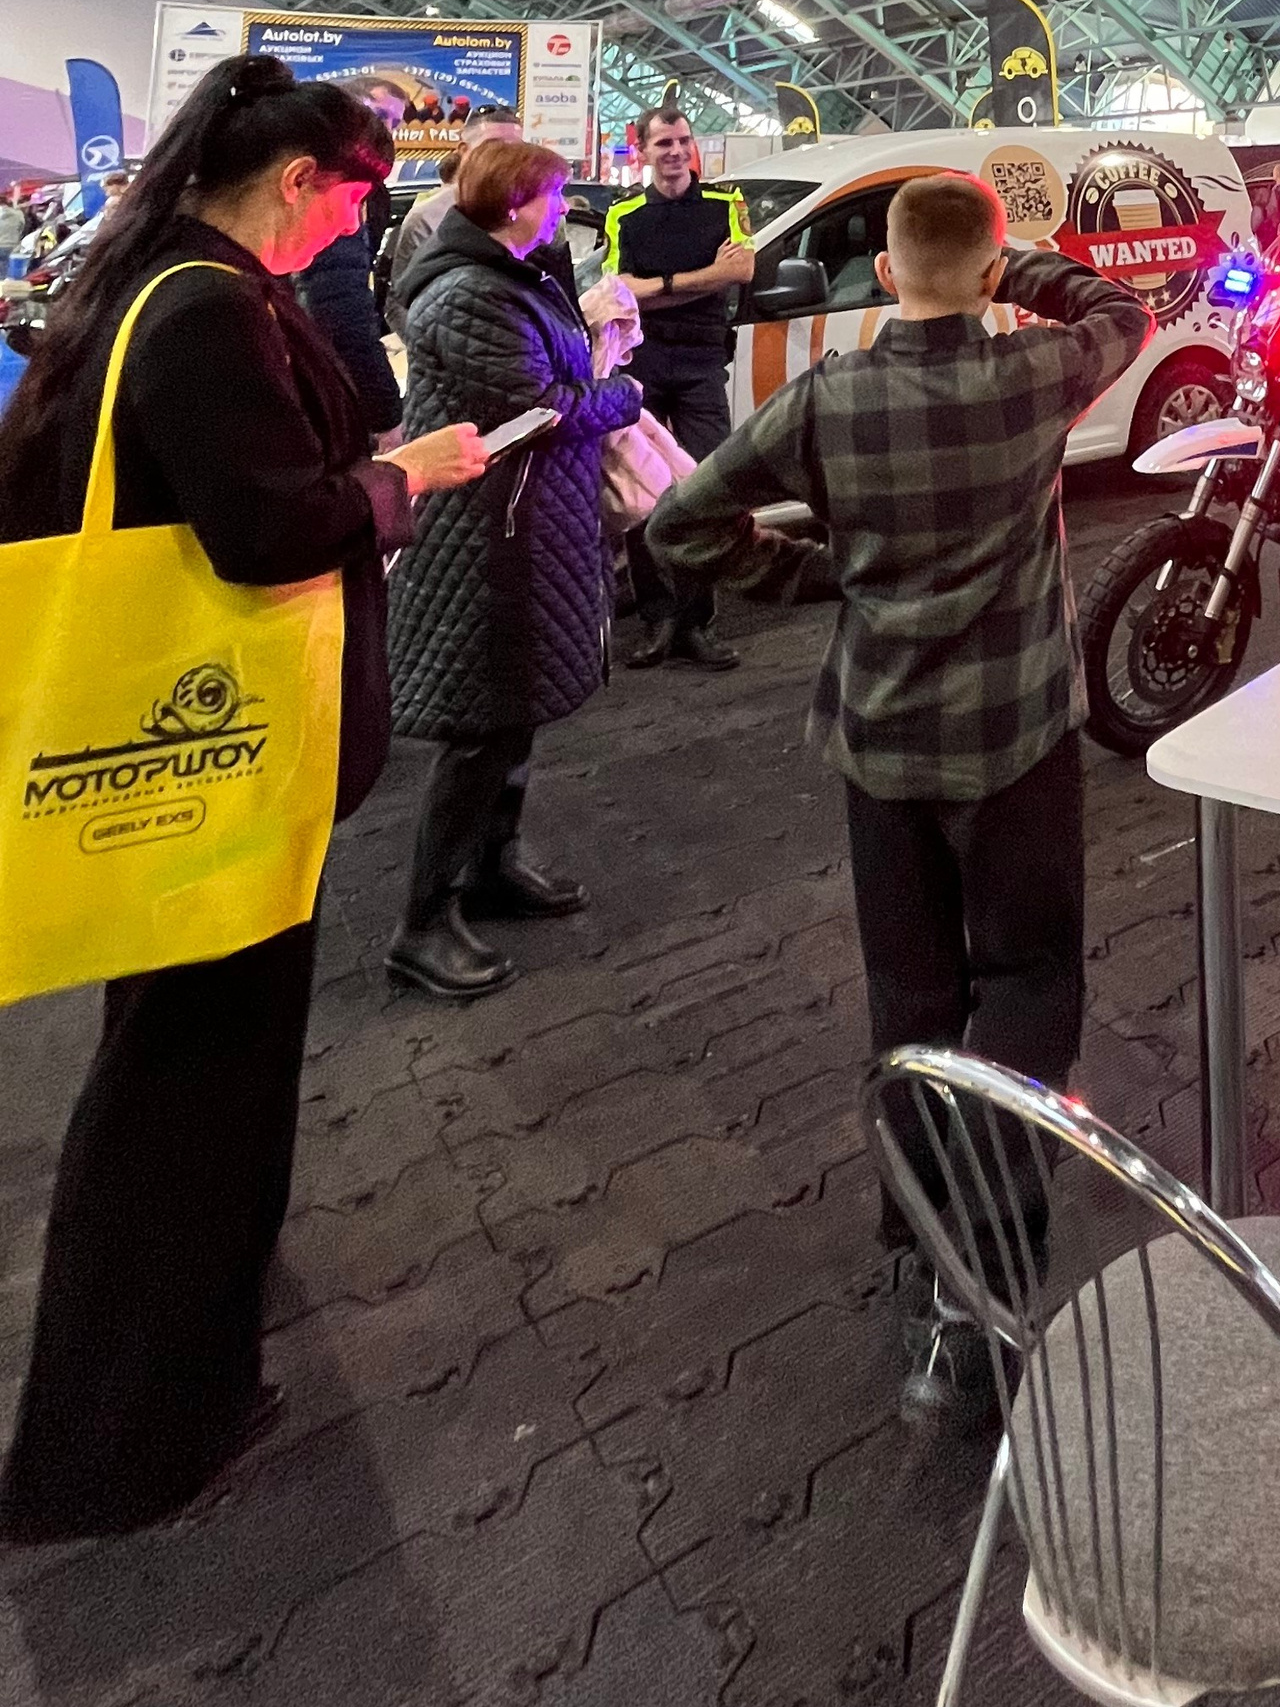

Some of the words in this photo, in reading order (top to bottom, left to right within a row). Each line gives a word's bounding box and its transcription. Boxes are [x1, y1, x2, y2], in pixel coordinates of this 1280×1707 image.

[262, 28, 342, 45] Autolot.by
[433, 35, 512, 49] Autolom.by
[259, 45, 312, 53] АУКЦИОН
[454, 59, 511, 67] СТРАХОВЫХ
[316, 66, 376, 82] 654-32-01
[404, 66, 431, 77] +375
[434, 71, 457, 85] (29)
[456, 67, 511, 75] ЗАПЧАСТЕЙ
[535, 92, 577, 103] asoba
[1094, 161, 1161, 190] COFFEE
[1089, 236, 1197, 268] WANTED
